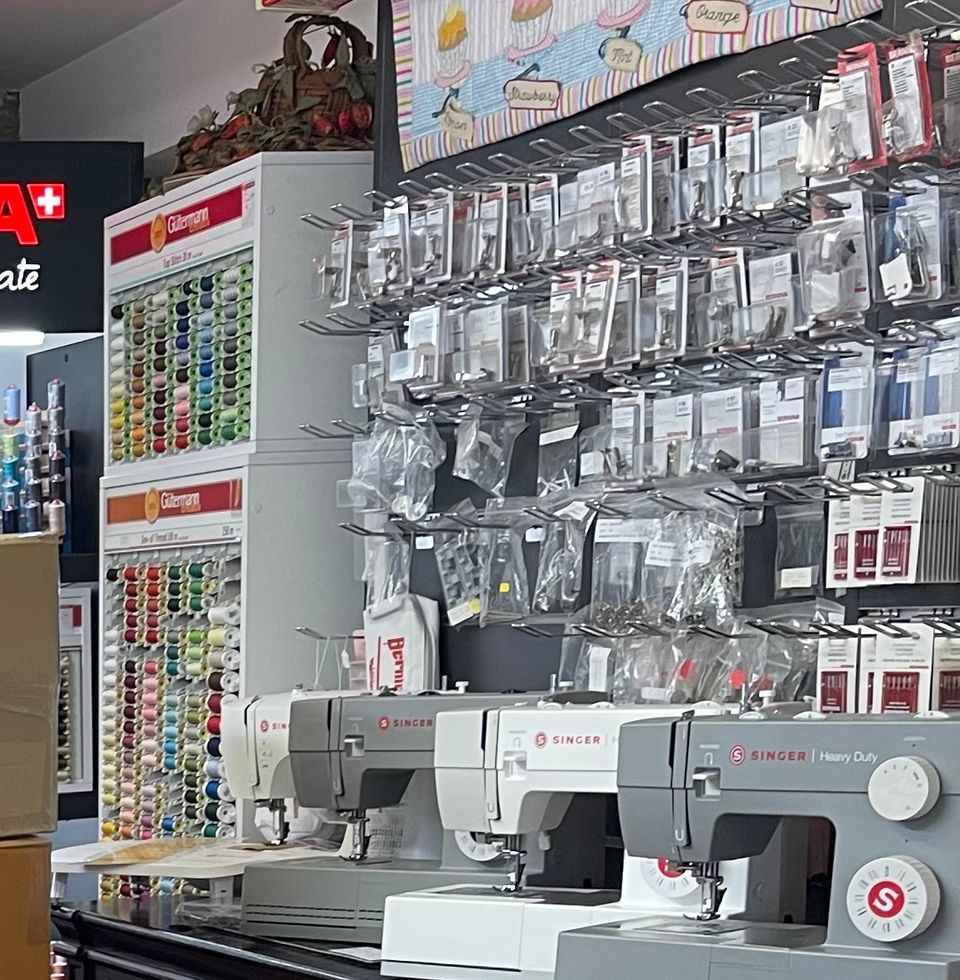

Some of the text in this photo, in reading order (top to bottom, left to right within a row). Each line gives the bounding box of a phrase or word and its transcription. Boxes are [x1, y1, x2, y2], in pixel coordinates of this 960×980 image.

[695, 3, 741, 26] Orange
[272, 722, 287, 730] SIN
[392, 719, 434, 728] SINGER
[552, 735, 601, 745] SINGER
[751, 751, 807, 761] SINGER
[819, 751, 852, 764] Heavy
[853, 751, 879, 763] Duty
